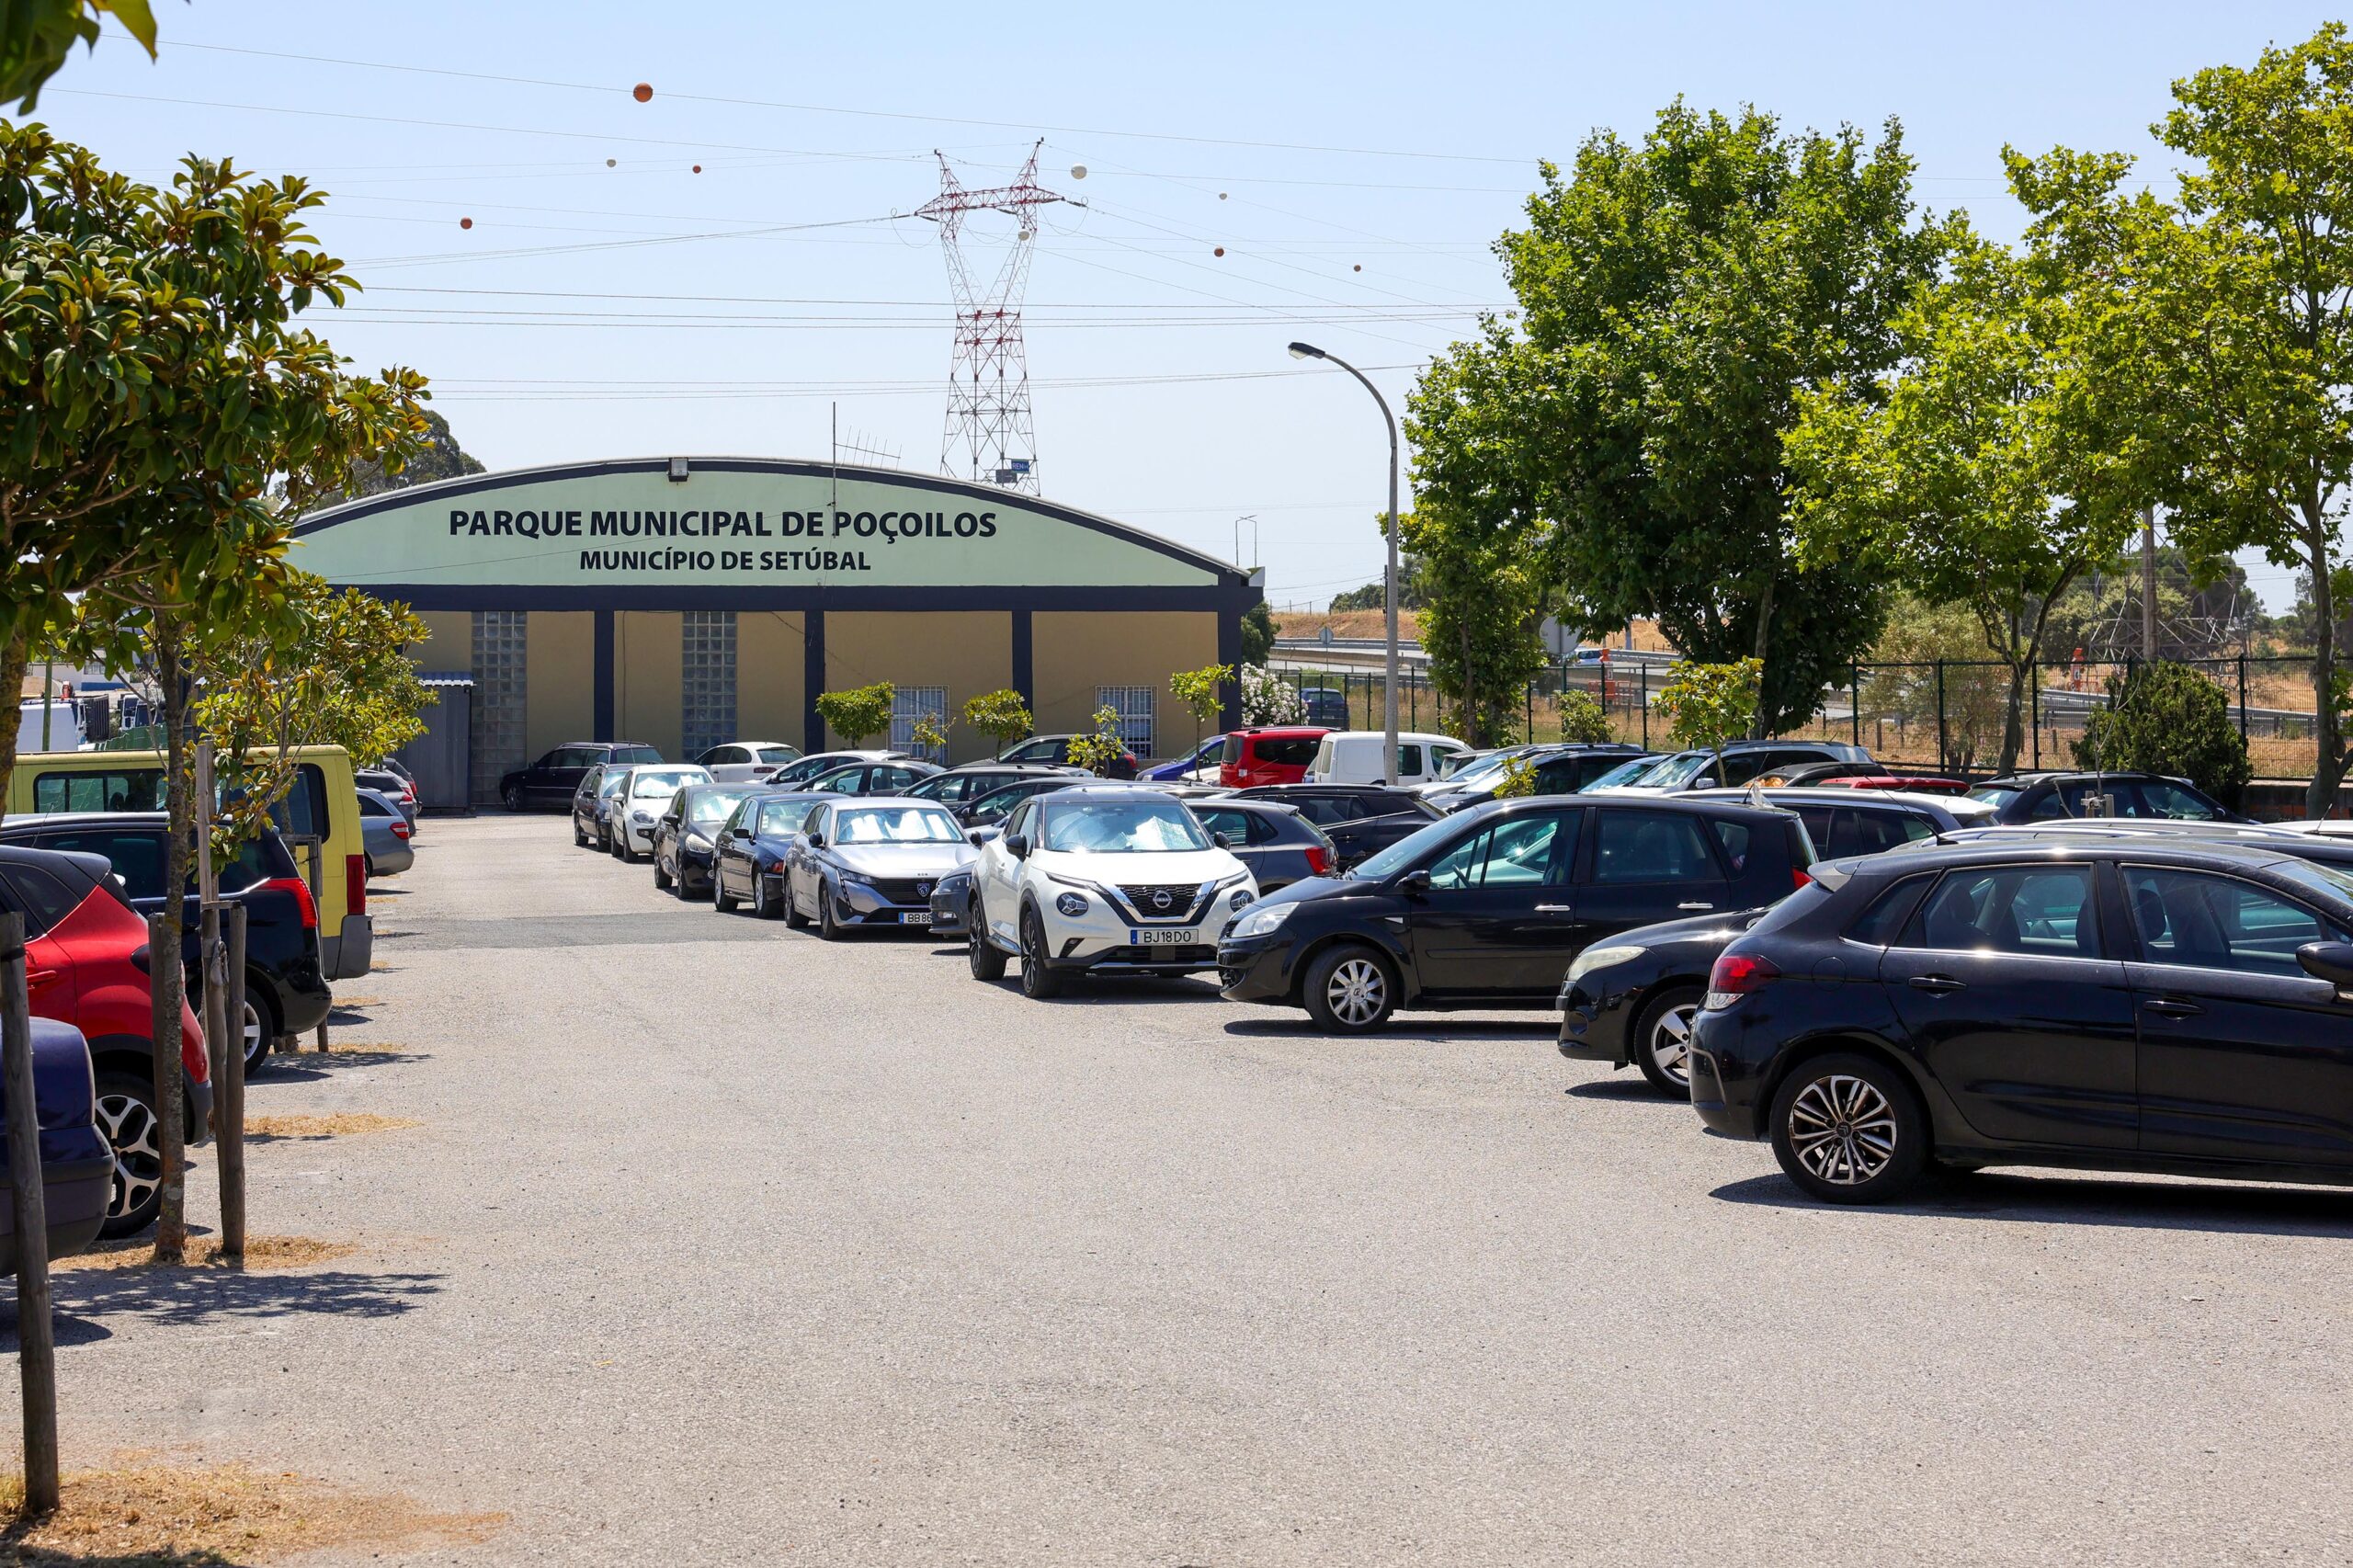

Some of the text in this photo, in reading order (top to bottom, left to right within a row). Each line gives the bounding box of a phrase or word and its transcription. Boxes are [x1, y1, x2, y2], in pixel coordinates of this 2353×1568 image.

[450, 511, 996, 544] PARQUE MUNICIPAL DE POÇOILOS
[581, 547, 871, 571] MUNICÍPIO DE SETÚBAL
